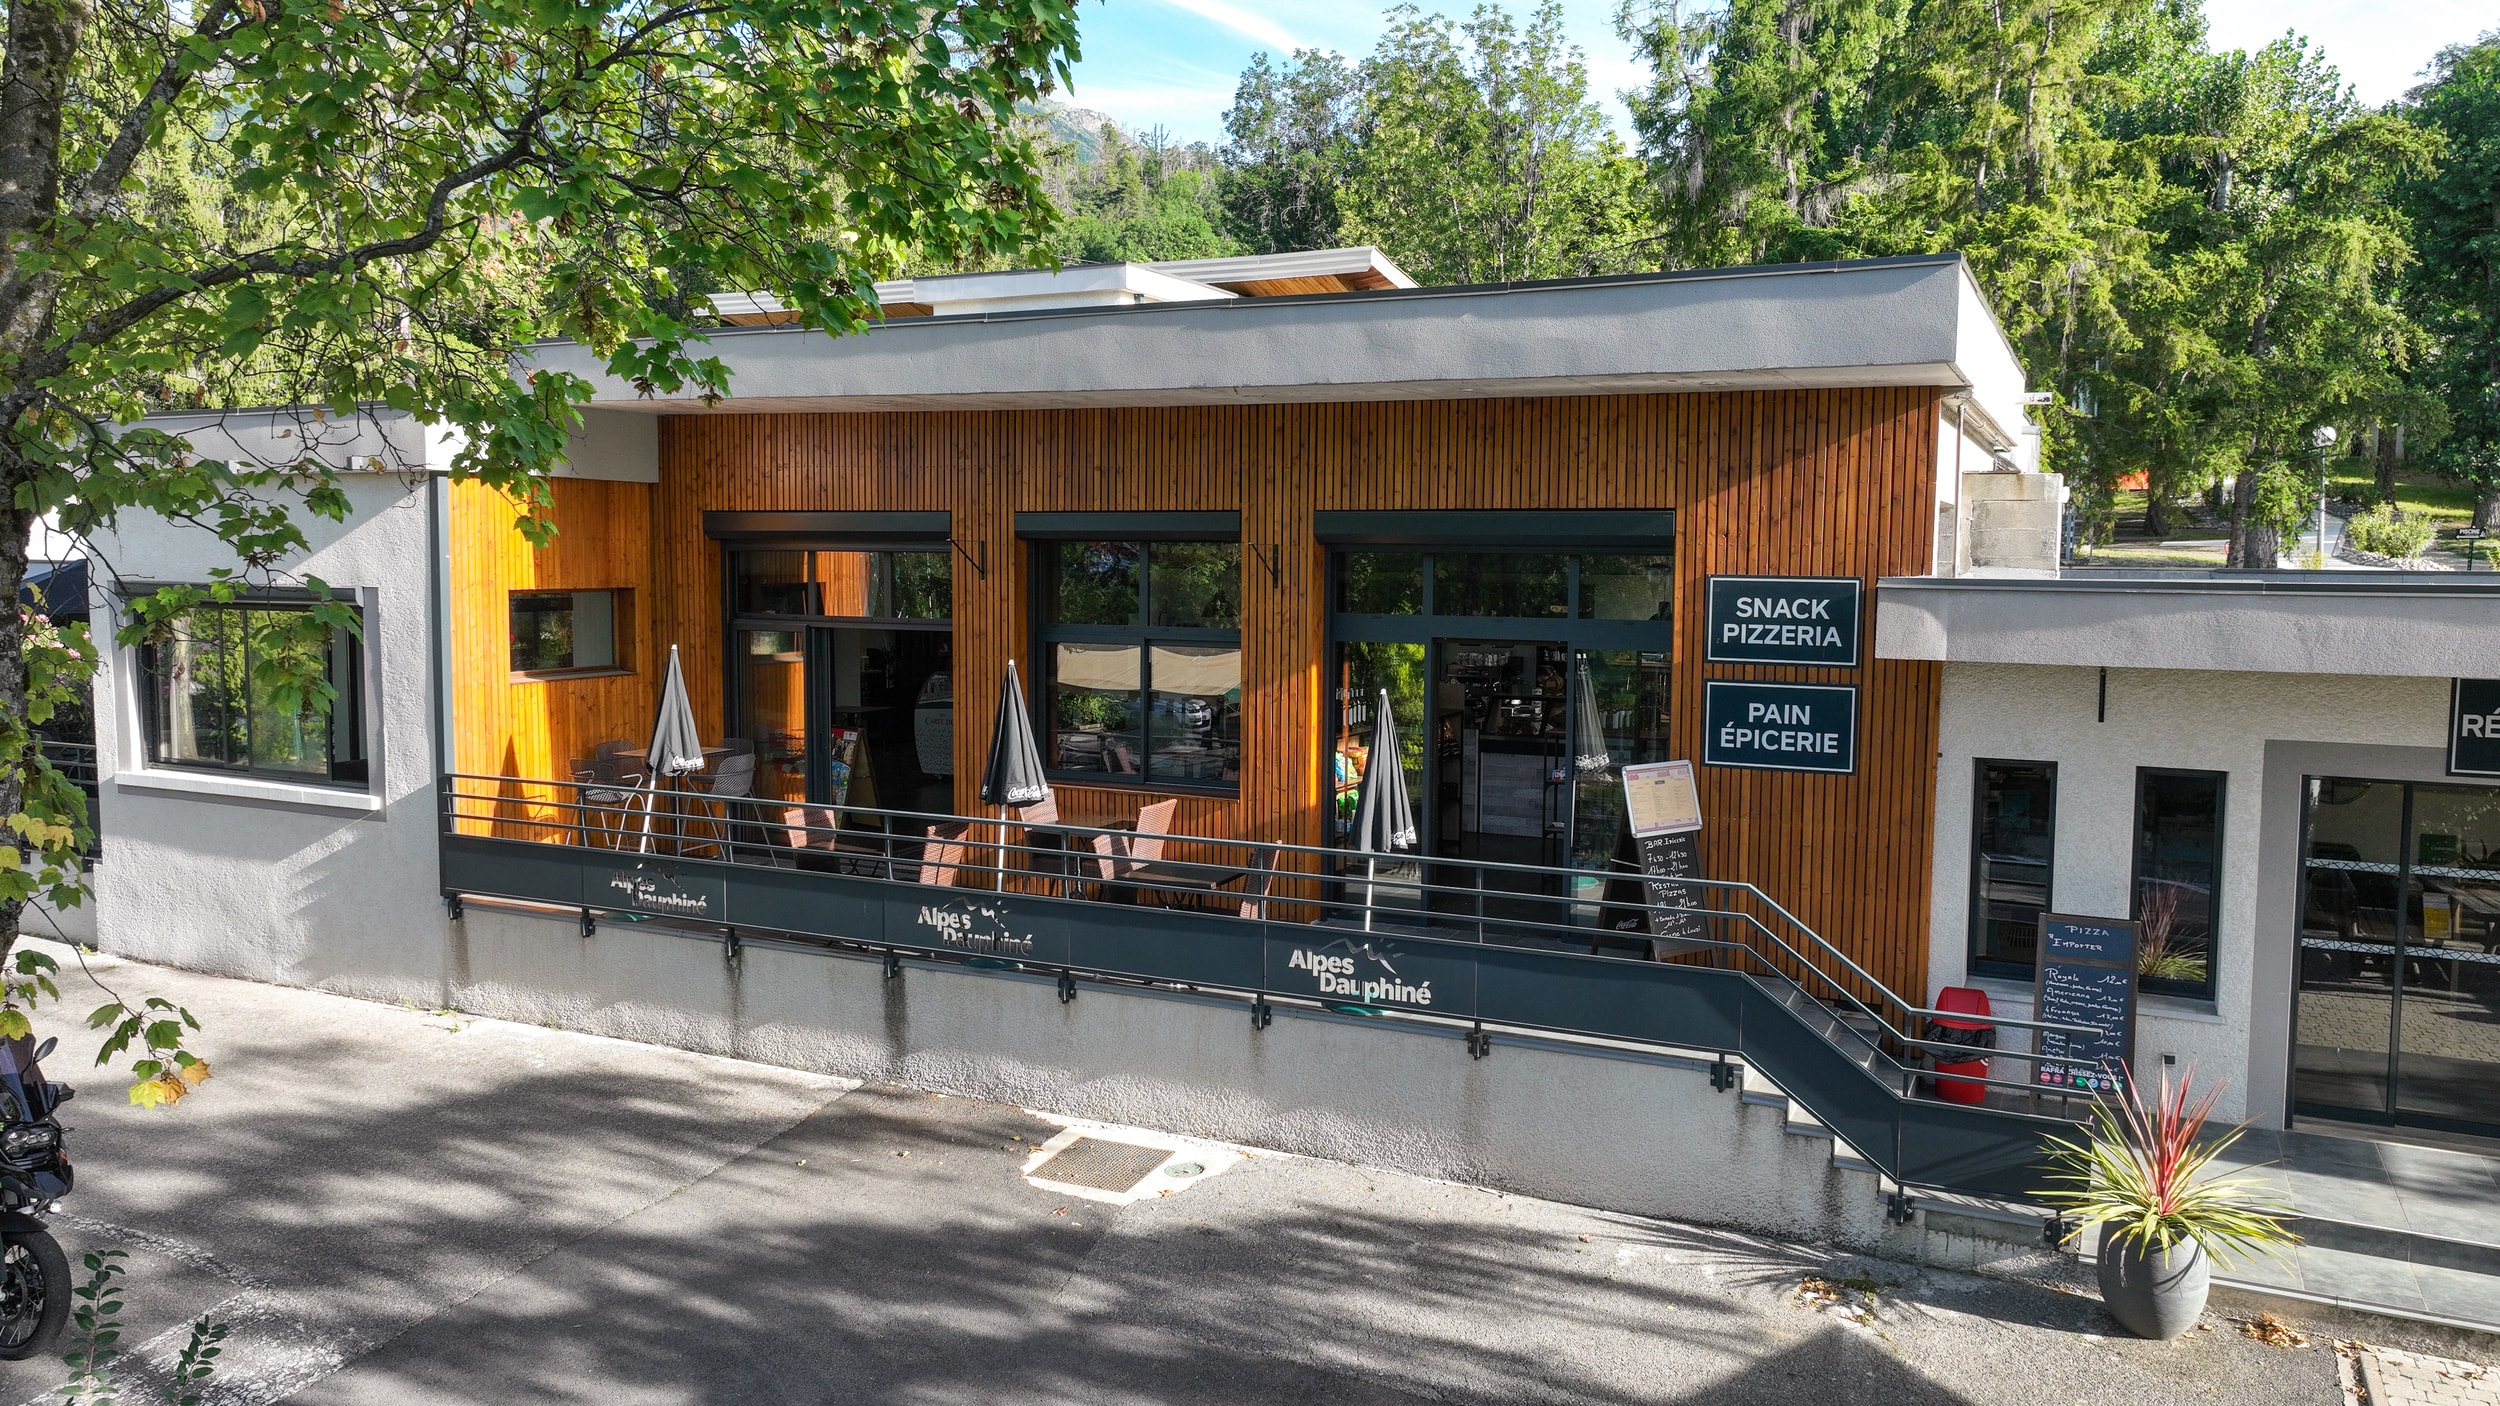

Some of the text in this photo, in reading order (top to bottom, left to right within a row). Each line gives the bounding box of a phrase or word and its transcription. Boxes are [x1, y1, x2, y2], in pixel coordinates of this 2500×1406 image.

[1736, 597, 1830, 620] SNACK
[1723, 623, 1842, 647] PIZZERIA
[1748, 702, 1811, 726] PAIN
[1720, 721, 1839, 754] ÉPICERIE
[1644, 840, 1663, 849] BAR
[917, 905, 1034, 957] Alpes Dauphiné
[2065, 925, 2109, 936] PIZZA
[1288, 948, 1432, 1005] Alpes Dauphiné
